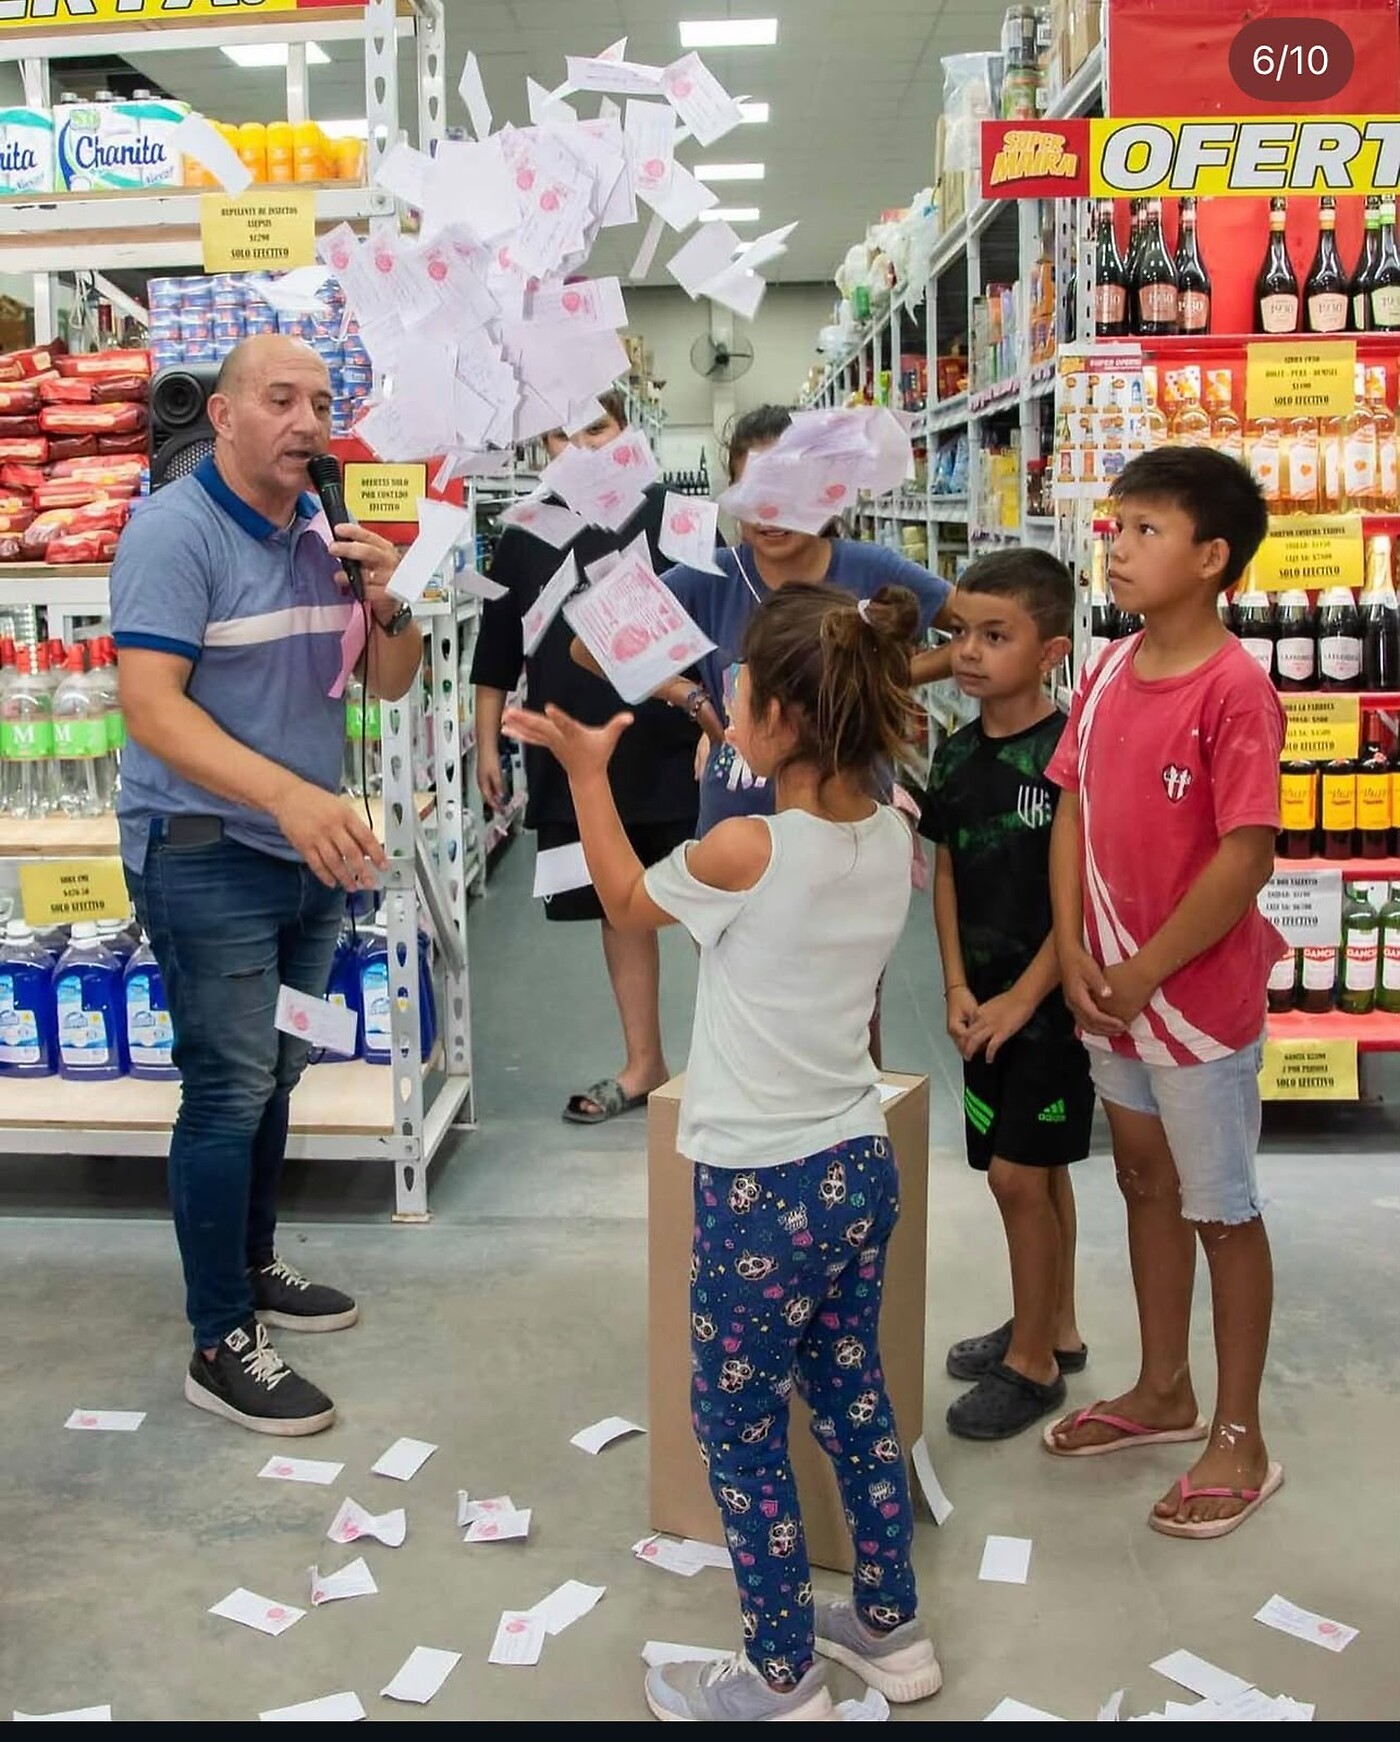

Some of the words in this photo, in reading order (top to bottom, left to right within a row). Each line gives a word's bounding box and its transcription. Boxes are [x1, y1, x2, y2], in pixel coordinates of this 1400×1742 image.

[76, 135, 167, 169] Chanita
[231, 249, 251, 258] SOLO
[253, 248, 289, 258] EFECTIVO
[1274, 396, 1293, 406] SOLO
[1295, 395, 1329, 406] EFECTIVO
[369, 503, 400, 512] EFECTIVO
[1279, 567, 1300, 579] SOLO
[1302, 566, 1340, 578] EFECTIVO
[1300, 741, 1335, 752] EFECTIVO
[50, 902, 70, 913] SOLO
[71, 900, 105, 912] EFECTIVO
[1282, 915, 1319, 927] EFECTIVO
[1276, 1078, 1296, 1088] SOLO
[1298, 1077, 1335, 1088] EFECTIVO
